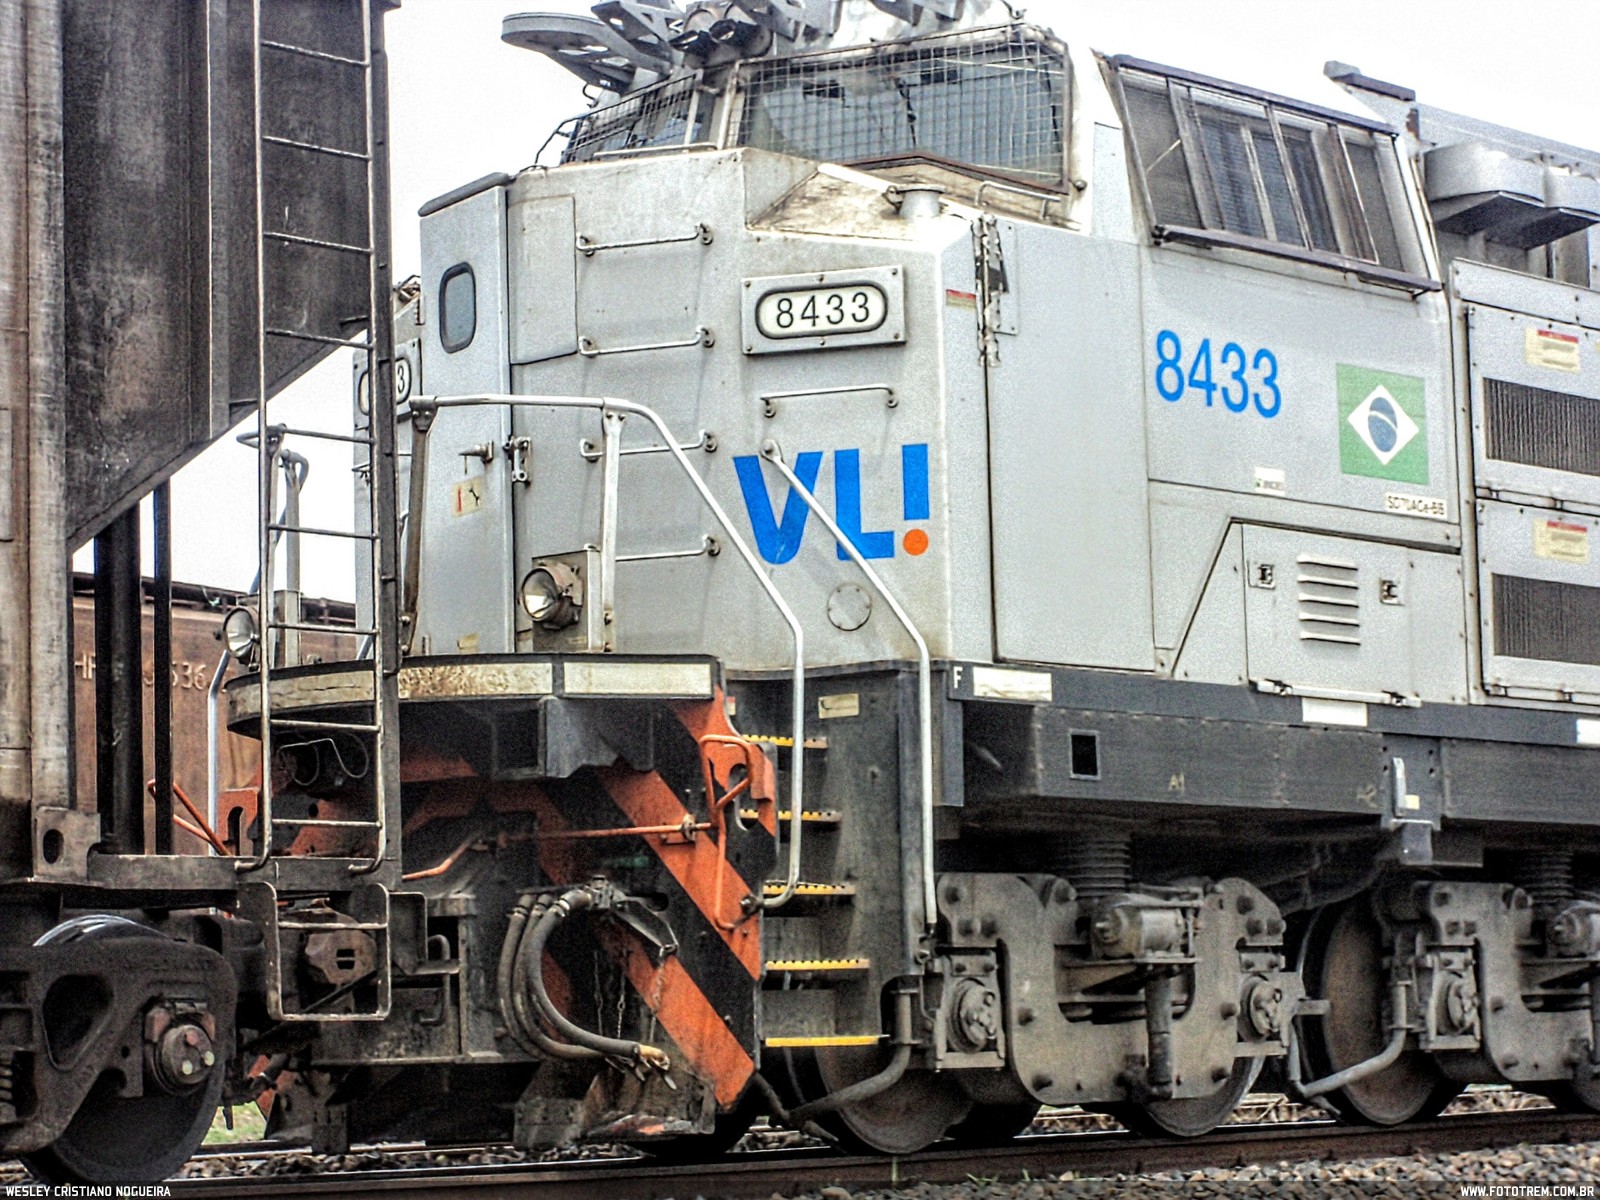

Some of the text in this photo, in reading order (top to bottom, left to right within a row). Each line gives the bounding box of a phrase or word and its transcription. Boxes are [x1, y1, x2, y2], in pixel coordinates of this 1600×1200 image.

[776, 291, 871, 329] 8433
[1155, 329, 1282, 419] 8433
[953, 665, 964, 689] F
